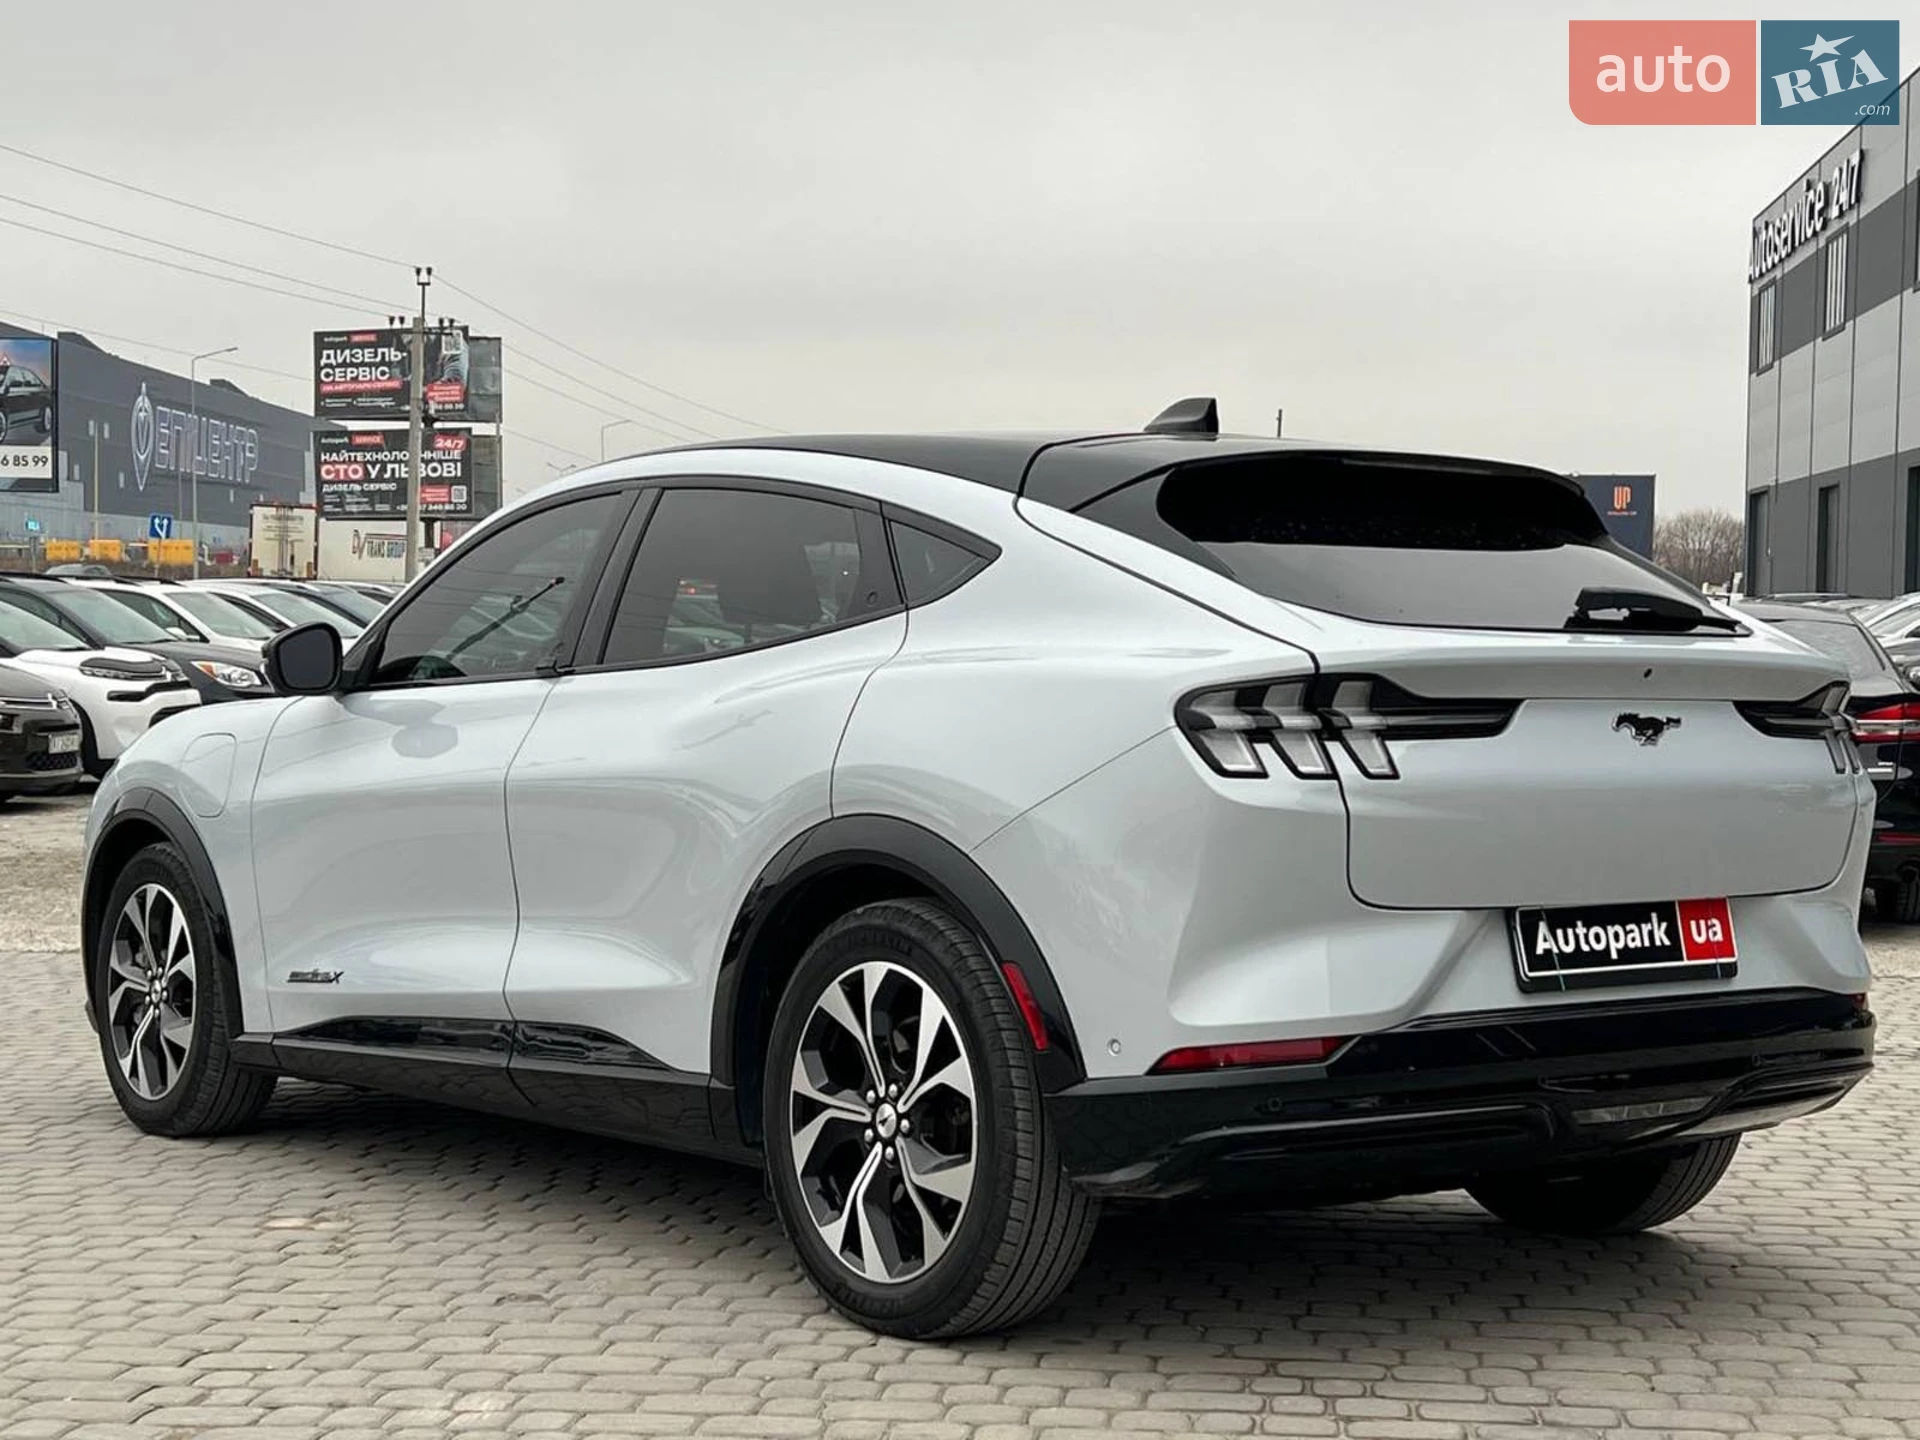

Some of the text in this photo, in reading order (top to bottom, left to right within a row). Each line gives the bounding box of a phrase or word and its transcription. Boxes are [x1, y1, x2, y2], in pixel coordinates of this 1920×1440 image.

[1831, 149, 1861, 219] 24/7
[320, 348, 408, 366] ДИЗЕЛЬ-
[320, 366, 390, 382] СЕРВІС
[435, 438, 464, 448] 24/7
[13, 454, 29, 467] 85
[32, 455, 49, 467] 99
[321, 465, 363, 479] СТО
[366, 464, 381, 479] У
[1613, 485, 1631, 509] UP
[1535, 912, 1724, 960] Autopark ua
